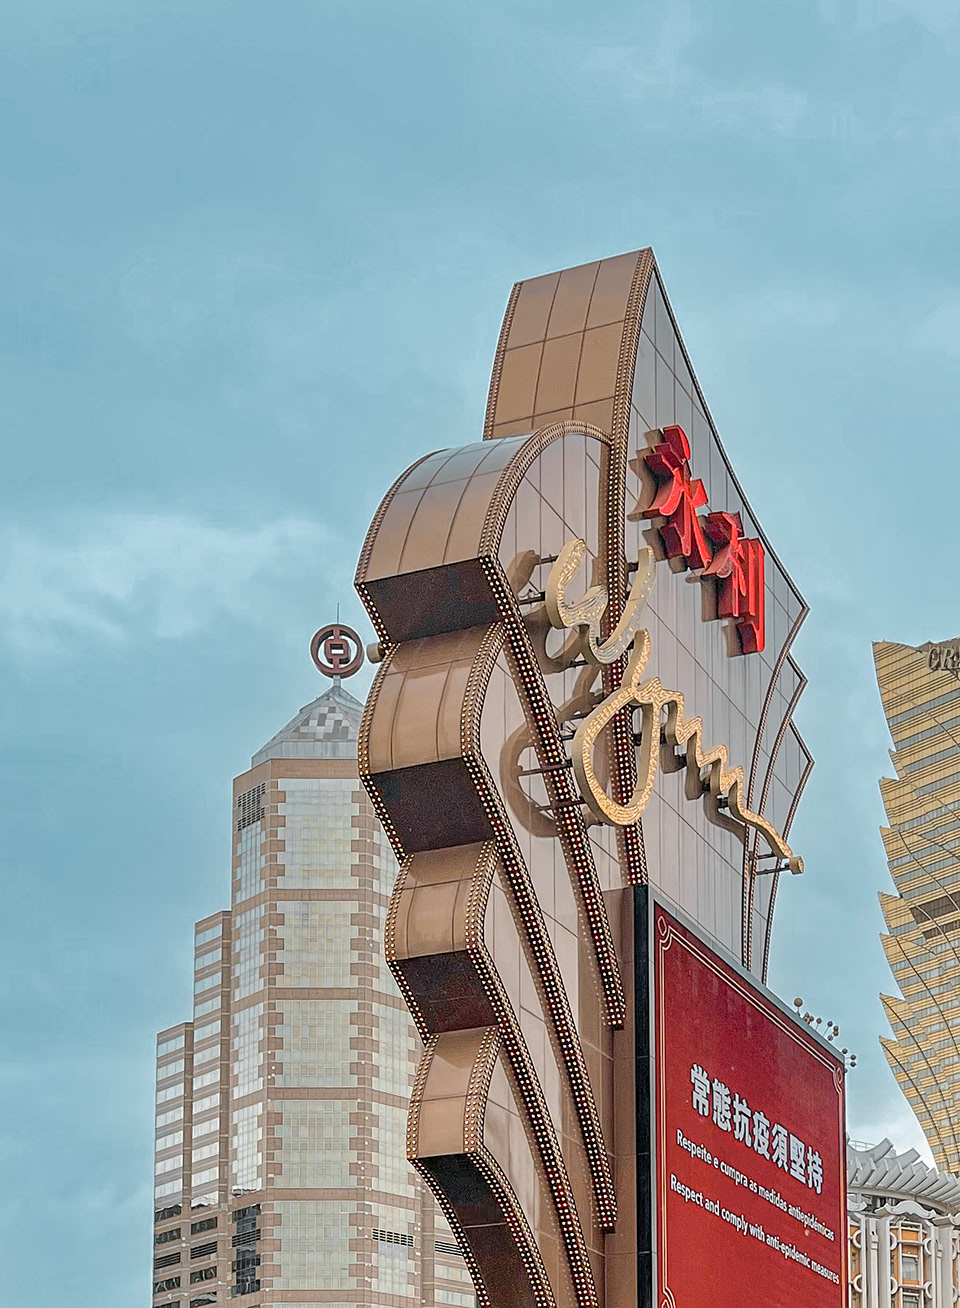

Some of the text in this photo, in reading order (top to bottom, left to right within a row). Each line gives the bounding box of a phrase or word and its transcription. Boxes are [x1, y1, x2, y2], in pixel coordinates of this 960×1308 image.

[676, 1128, 835, 1241] Respeite e cumpra as medidas antiepidémicas
[690, 1063, 824, 1195] 常態抗疫須堅持
[670, 1173, 840, 1284] Respect and comply with anti-epidemic measures
